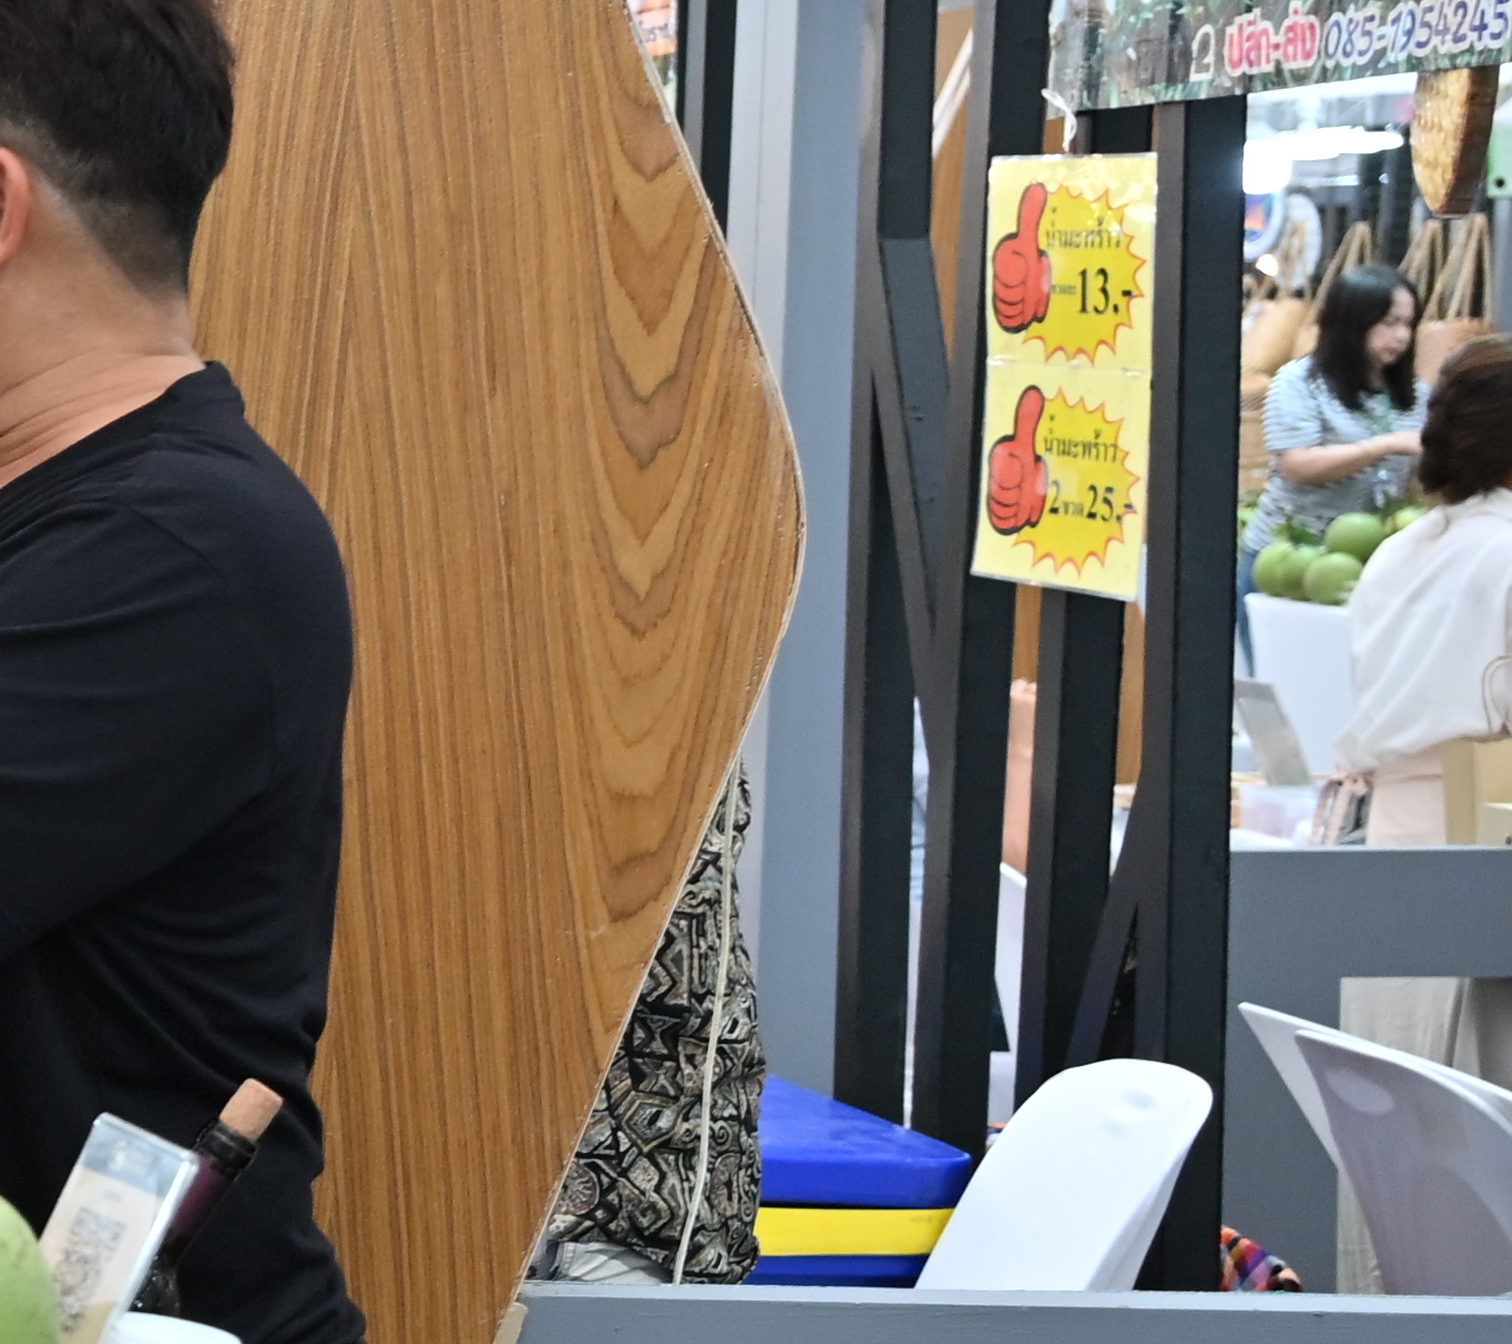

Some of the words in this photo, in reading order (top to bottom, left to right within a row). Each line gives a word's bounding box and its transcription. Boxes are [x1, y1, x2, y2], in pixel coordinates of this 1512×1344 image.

[1045, 206, 1122, 249] น้ำมะพร้าว
[1078, 267, 1133, 315] 13.-
[1044, 414, 1119, 463] น้ำมะพร้าว
